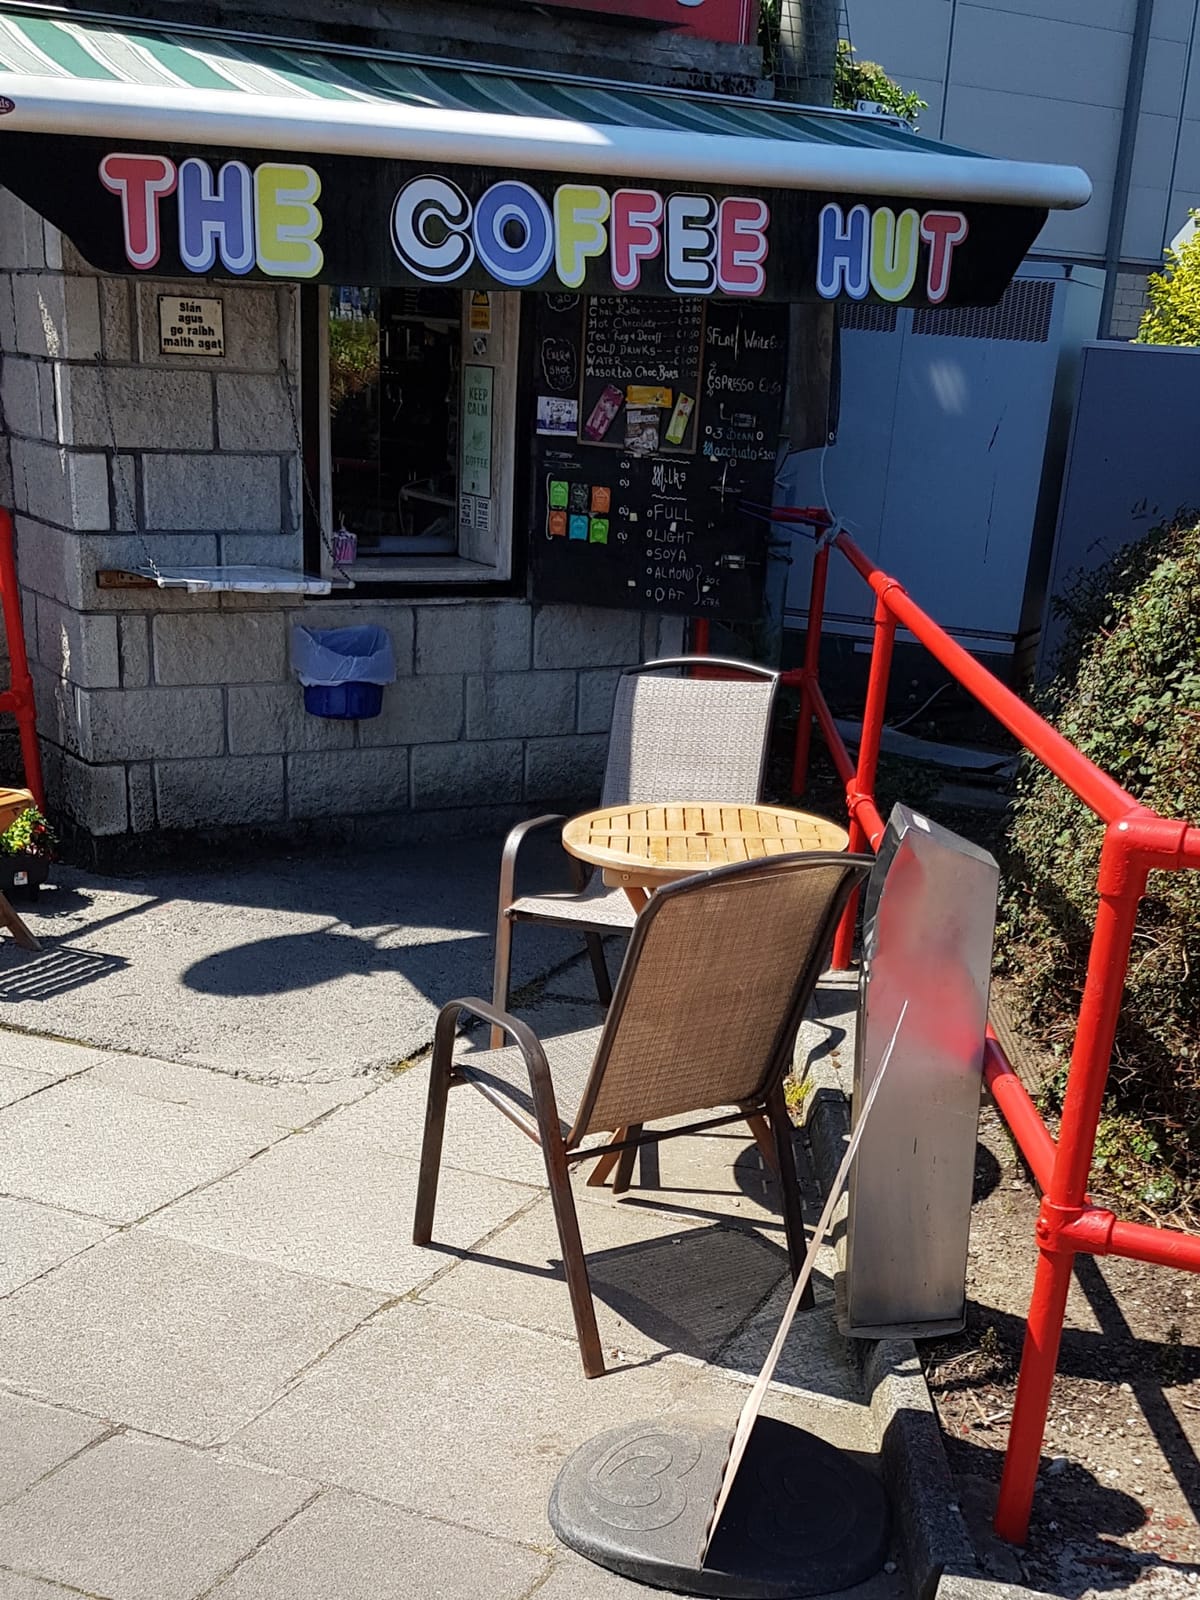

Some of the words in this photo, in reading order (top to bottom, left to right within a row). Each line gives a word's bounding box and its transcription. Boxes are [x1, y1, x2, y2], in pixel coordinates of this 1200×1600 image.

[99, 151, 325, 279] THE
[390, 173, 770, 297] COFFEE
[815, 201, 969, 304] HUT
[179, 301, 202, 313] Slán
[178, 314, 204, 326] agus
[170, 326, 184, 337] go
[187, 325, 216, 337] raibh
[163, 336, 195, 348] maith
[468, 386, 489, 402] KEEP
[467, 400, 488, 417] CALM
[654, 503, 695, 524] FULL
[653, 529, 696, 545] LIGHT
[653, 547, 688, 563] SOYA
[653, 586, 687, 603] OAT
